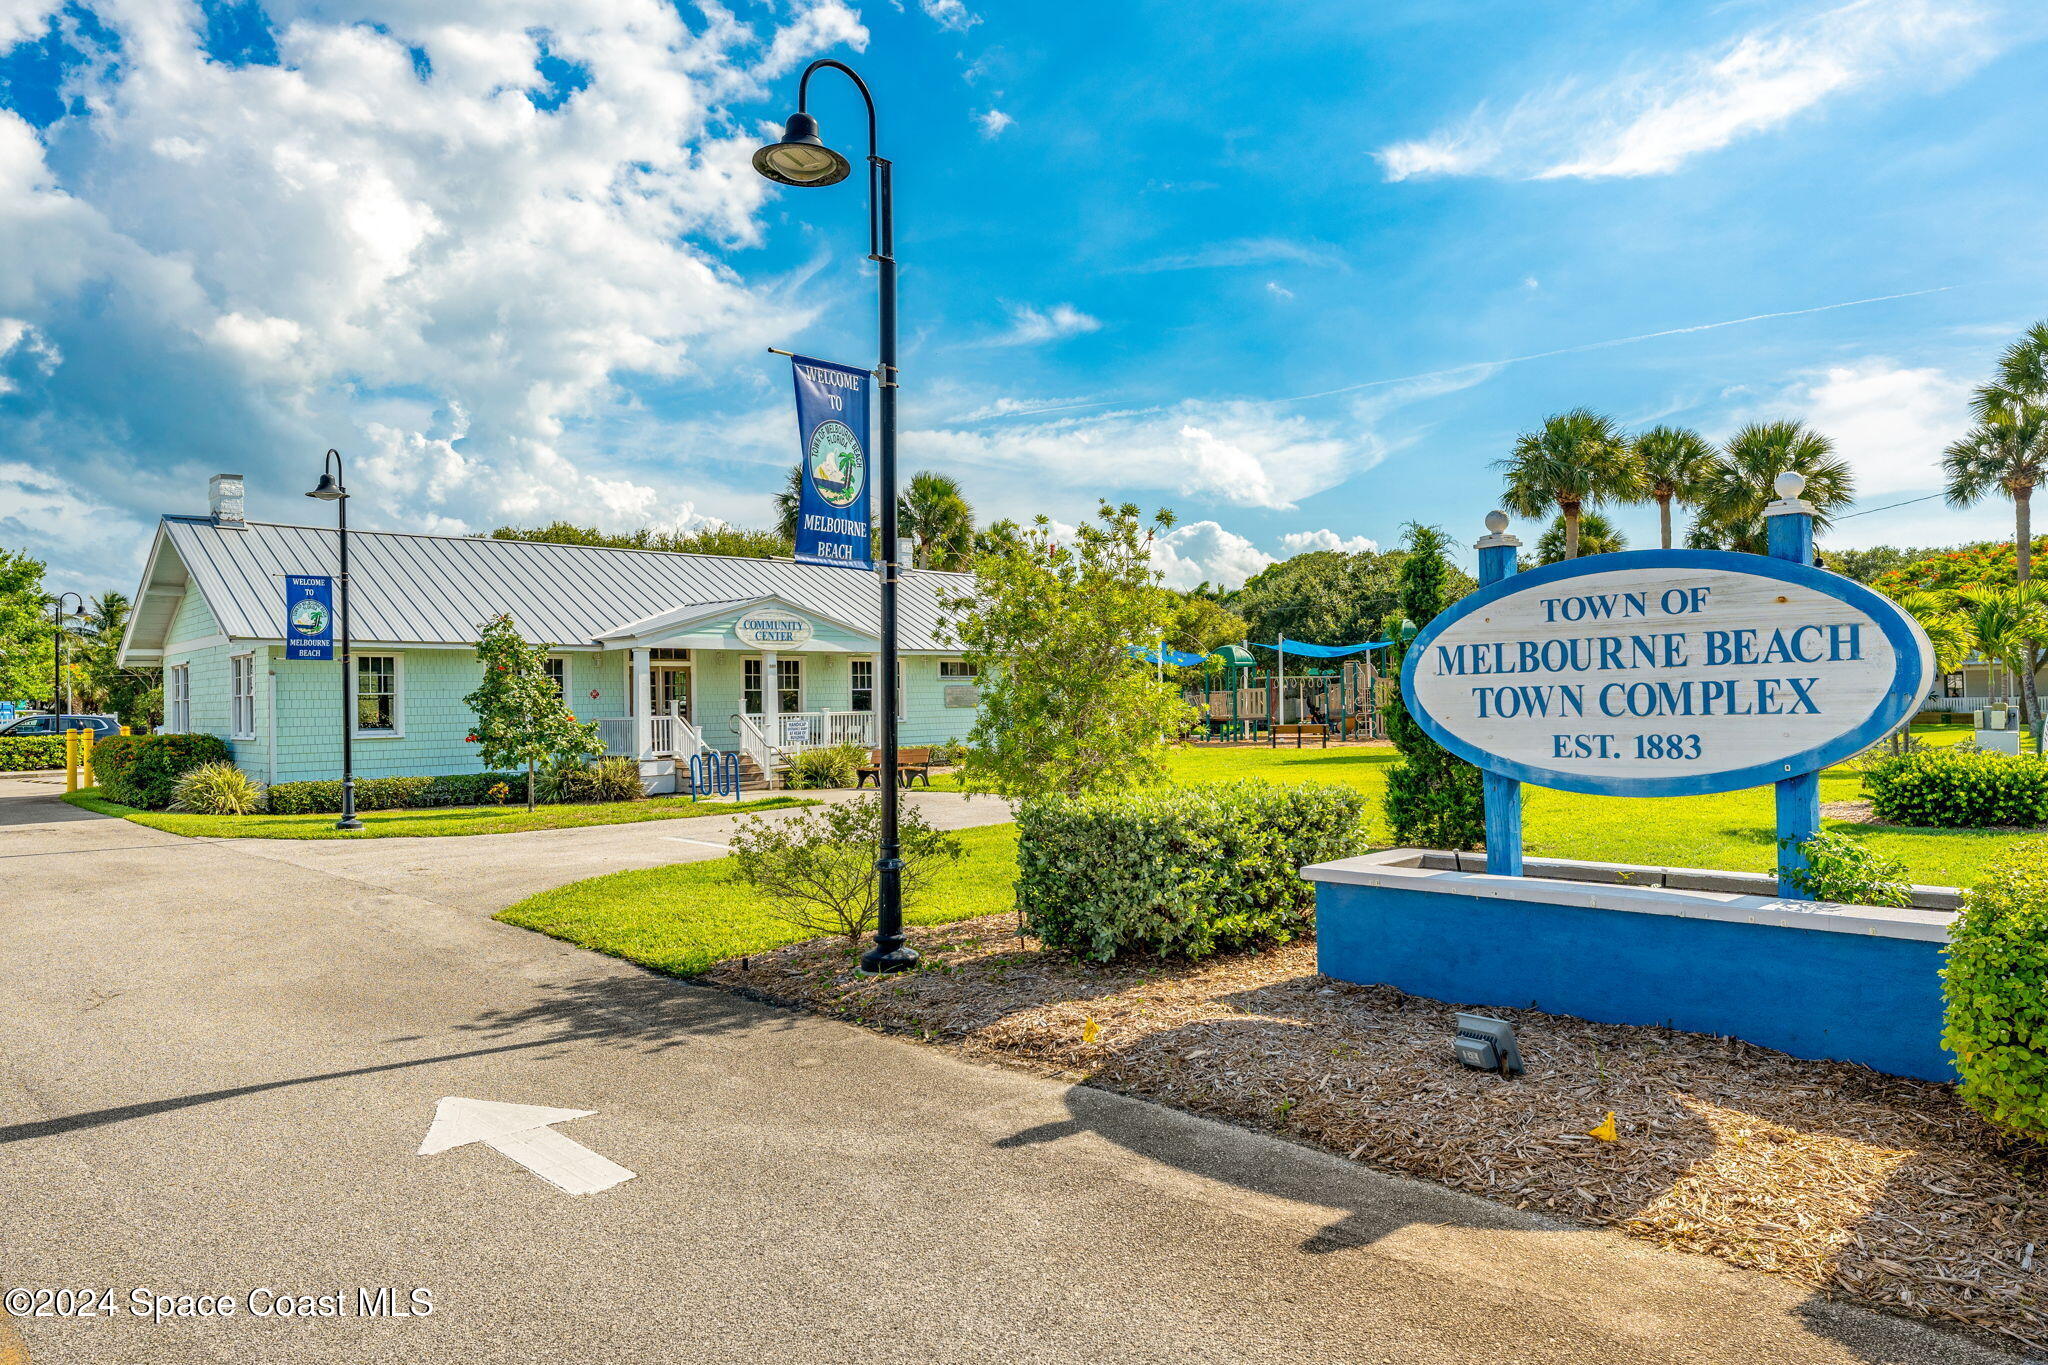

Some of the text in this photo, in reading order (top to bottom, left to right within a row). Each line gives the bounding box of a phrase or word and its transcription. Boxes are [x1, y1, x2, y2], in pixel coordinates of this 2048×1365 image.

[806, 366, 859, 391] WELCOME
[828, 394, 843, 411] TO
[811, 424, 863, 468] TOWN OF MELBOURNE BEACH
[826, 434, 849, 450] FLORIDA
[804, 513, 867, 538] MELBOURNE
[817, 541, 853, 560] BEACH
[293, 578, 325, 586] WELCOME
[1540, 586, 1712, 623] TOWN OF
[743, 619, 803, 631] COMMUNITY
[290, 639, 330, 647] MELBOURNE
[755, 631, 794, 641] CENTER
[299, 649, 320, 657] BEACH
[1435, 623, 1865, 676] MELBOURNE BEACH
[1471, 677, 1822, 719] TOWN COMPLEX
[1552, 733, 1702, 761] EST. 1883
